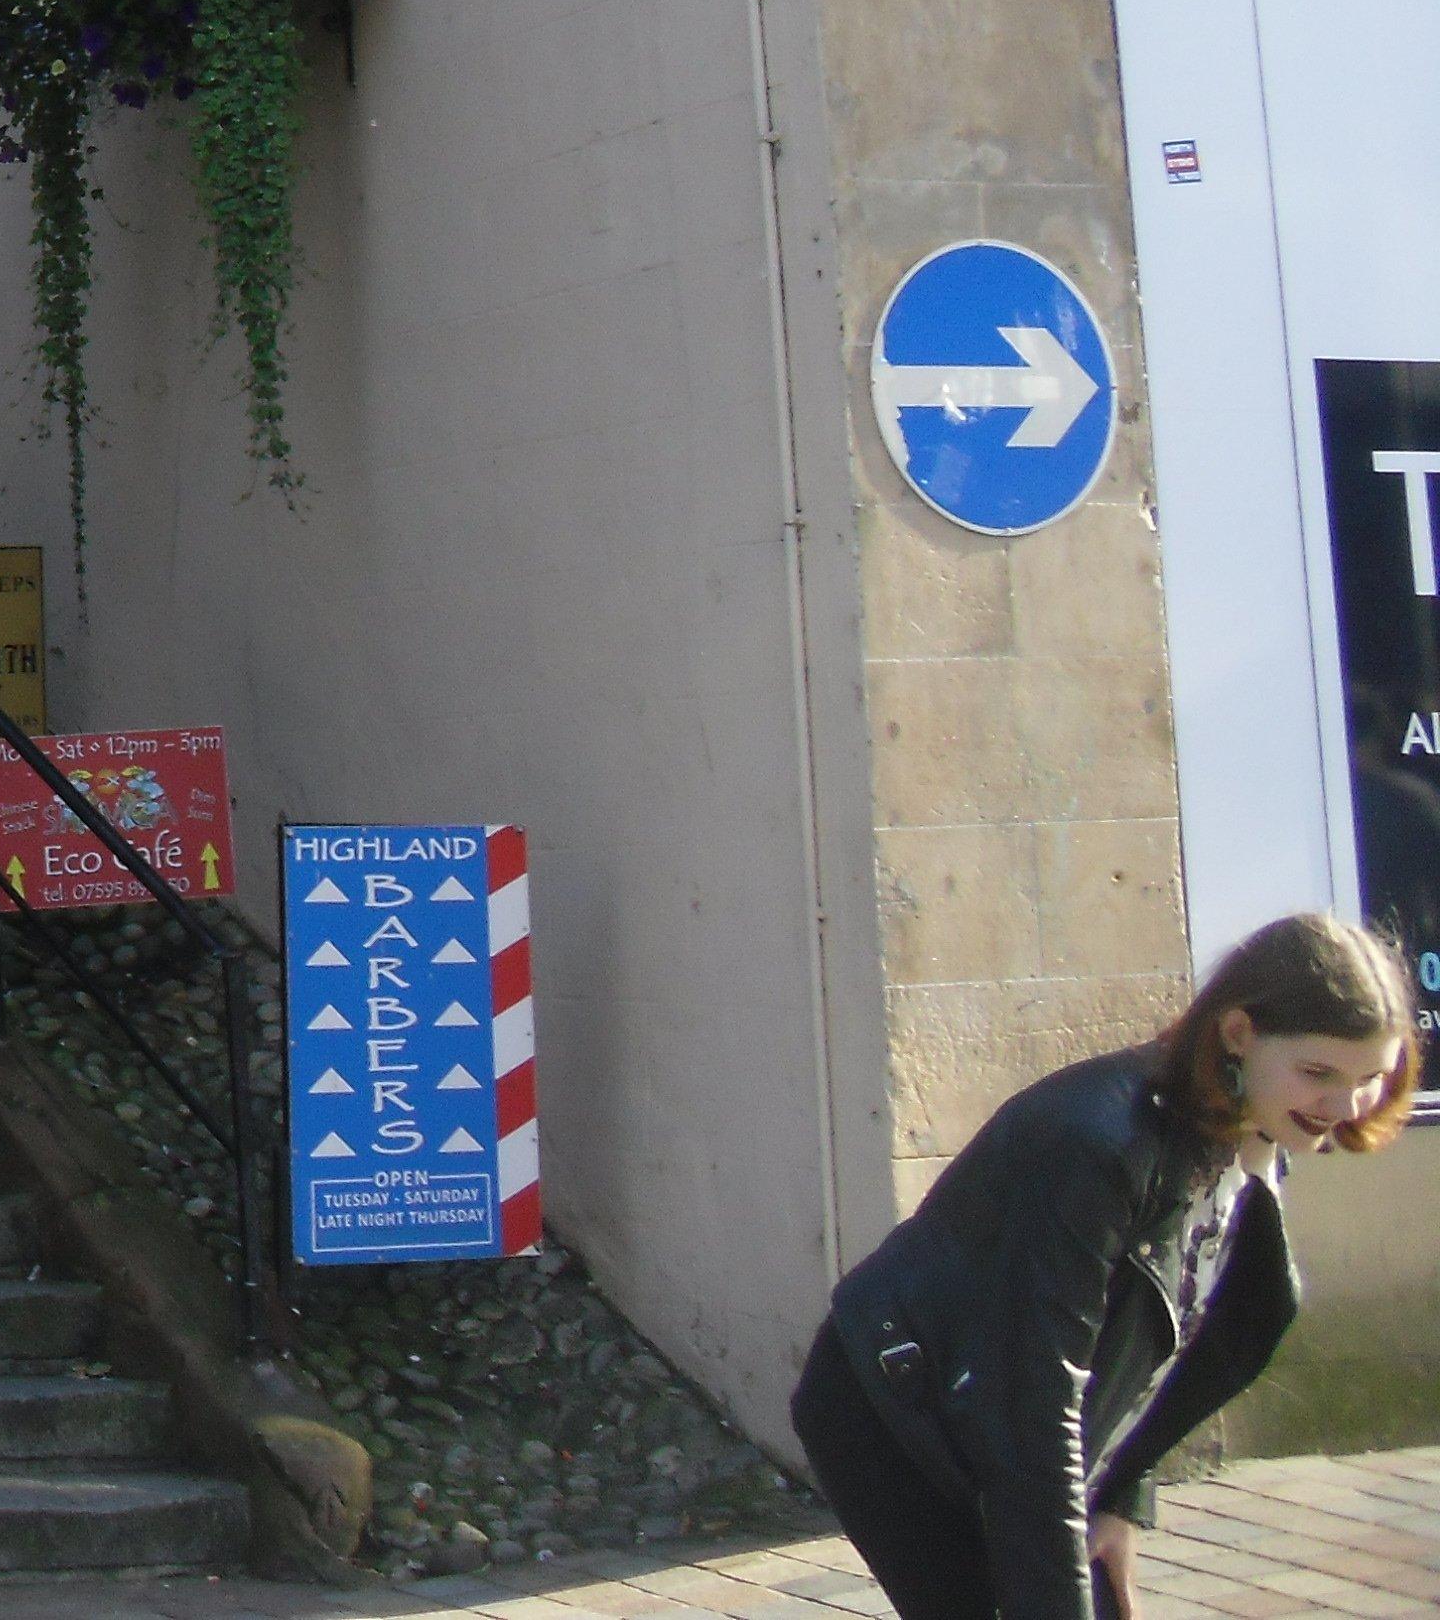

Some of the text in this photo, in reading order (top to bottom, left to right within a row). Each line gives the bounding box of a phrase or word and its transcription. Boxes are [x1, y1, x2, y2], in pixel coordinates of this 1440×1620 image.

[56, 739, 84, 761] Sat
[105, 736, 159, 761] 12pm
[44, 845, 102, 876] Eco
[294, 836, 478, 862] HIGHLAND
[72, 880, 124, 901] 07595
[362, 874, 425, 1156] BARBERS
[373, 1169, 429, 1187] OPEN
[323, 1192, 390, 1209] TUESDAY
[404, 1187, 480, 1205] SATURDAY
[318, 1208, 486, 1229] LATE NIGHT THURSDAY
